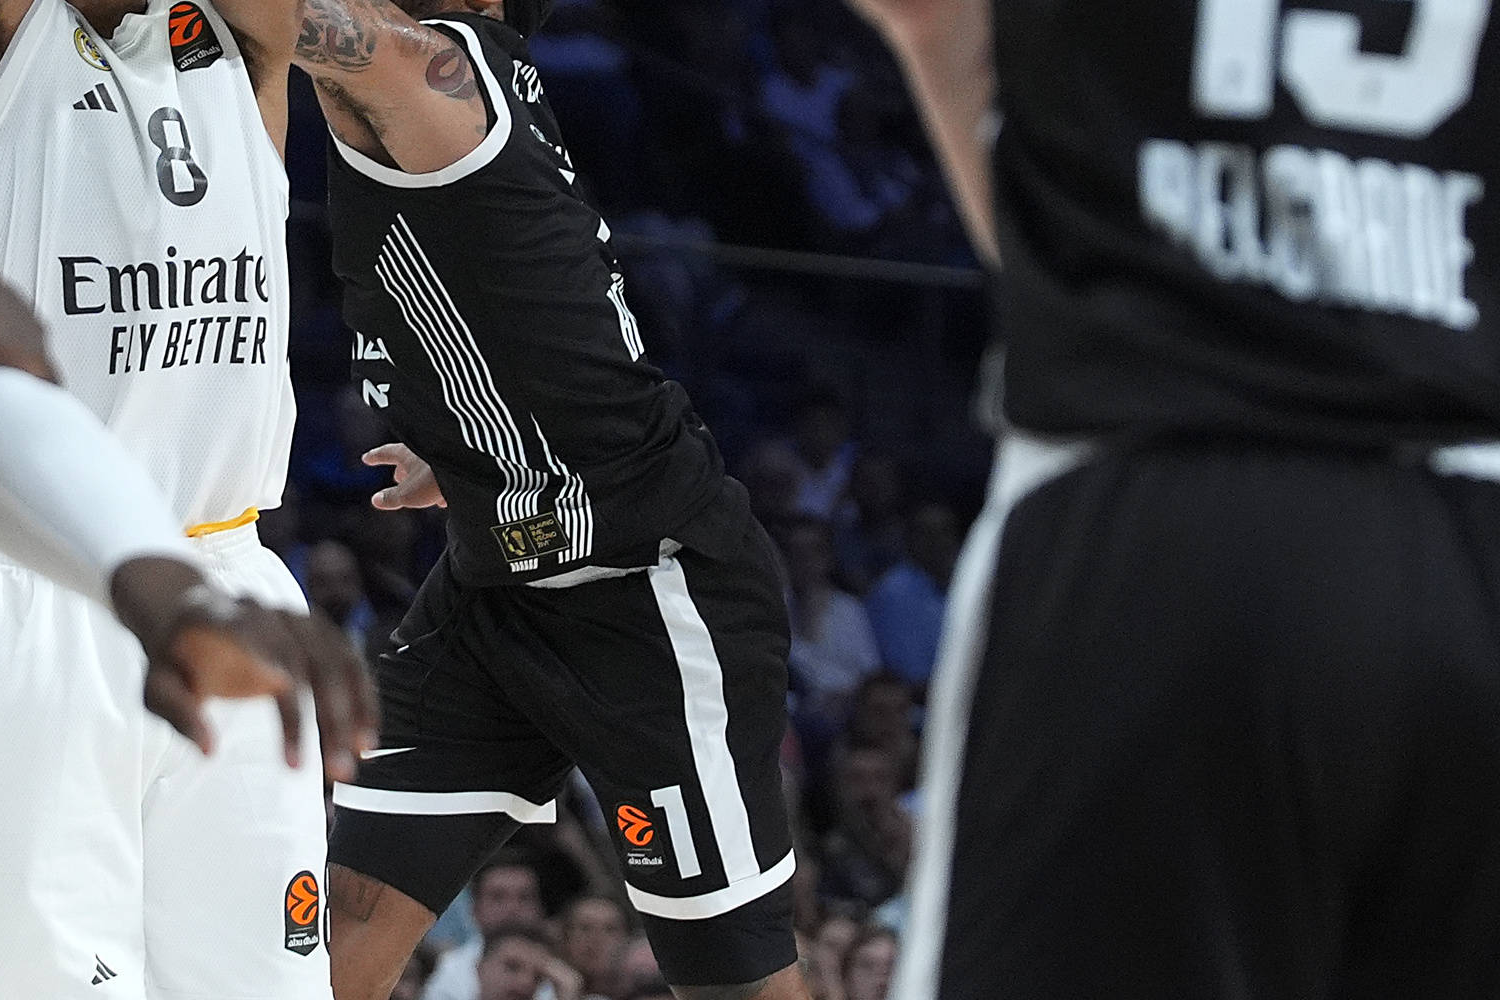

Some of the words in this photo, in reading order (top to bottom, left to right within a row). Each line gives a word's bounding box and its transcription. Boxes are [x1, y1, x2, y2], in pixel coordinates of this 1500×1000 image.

[147, 106, 209, 208] 8
[57, 245, 269, 315] Emirate
[108, 323, 158, 375] FLY
[161, 315, 267, 369] BETTER
[650, 785, 702, 879] 1
